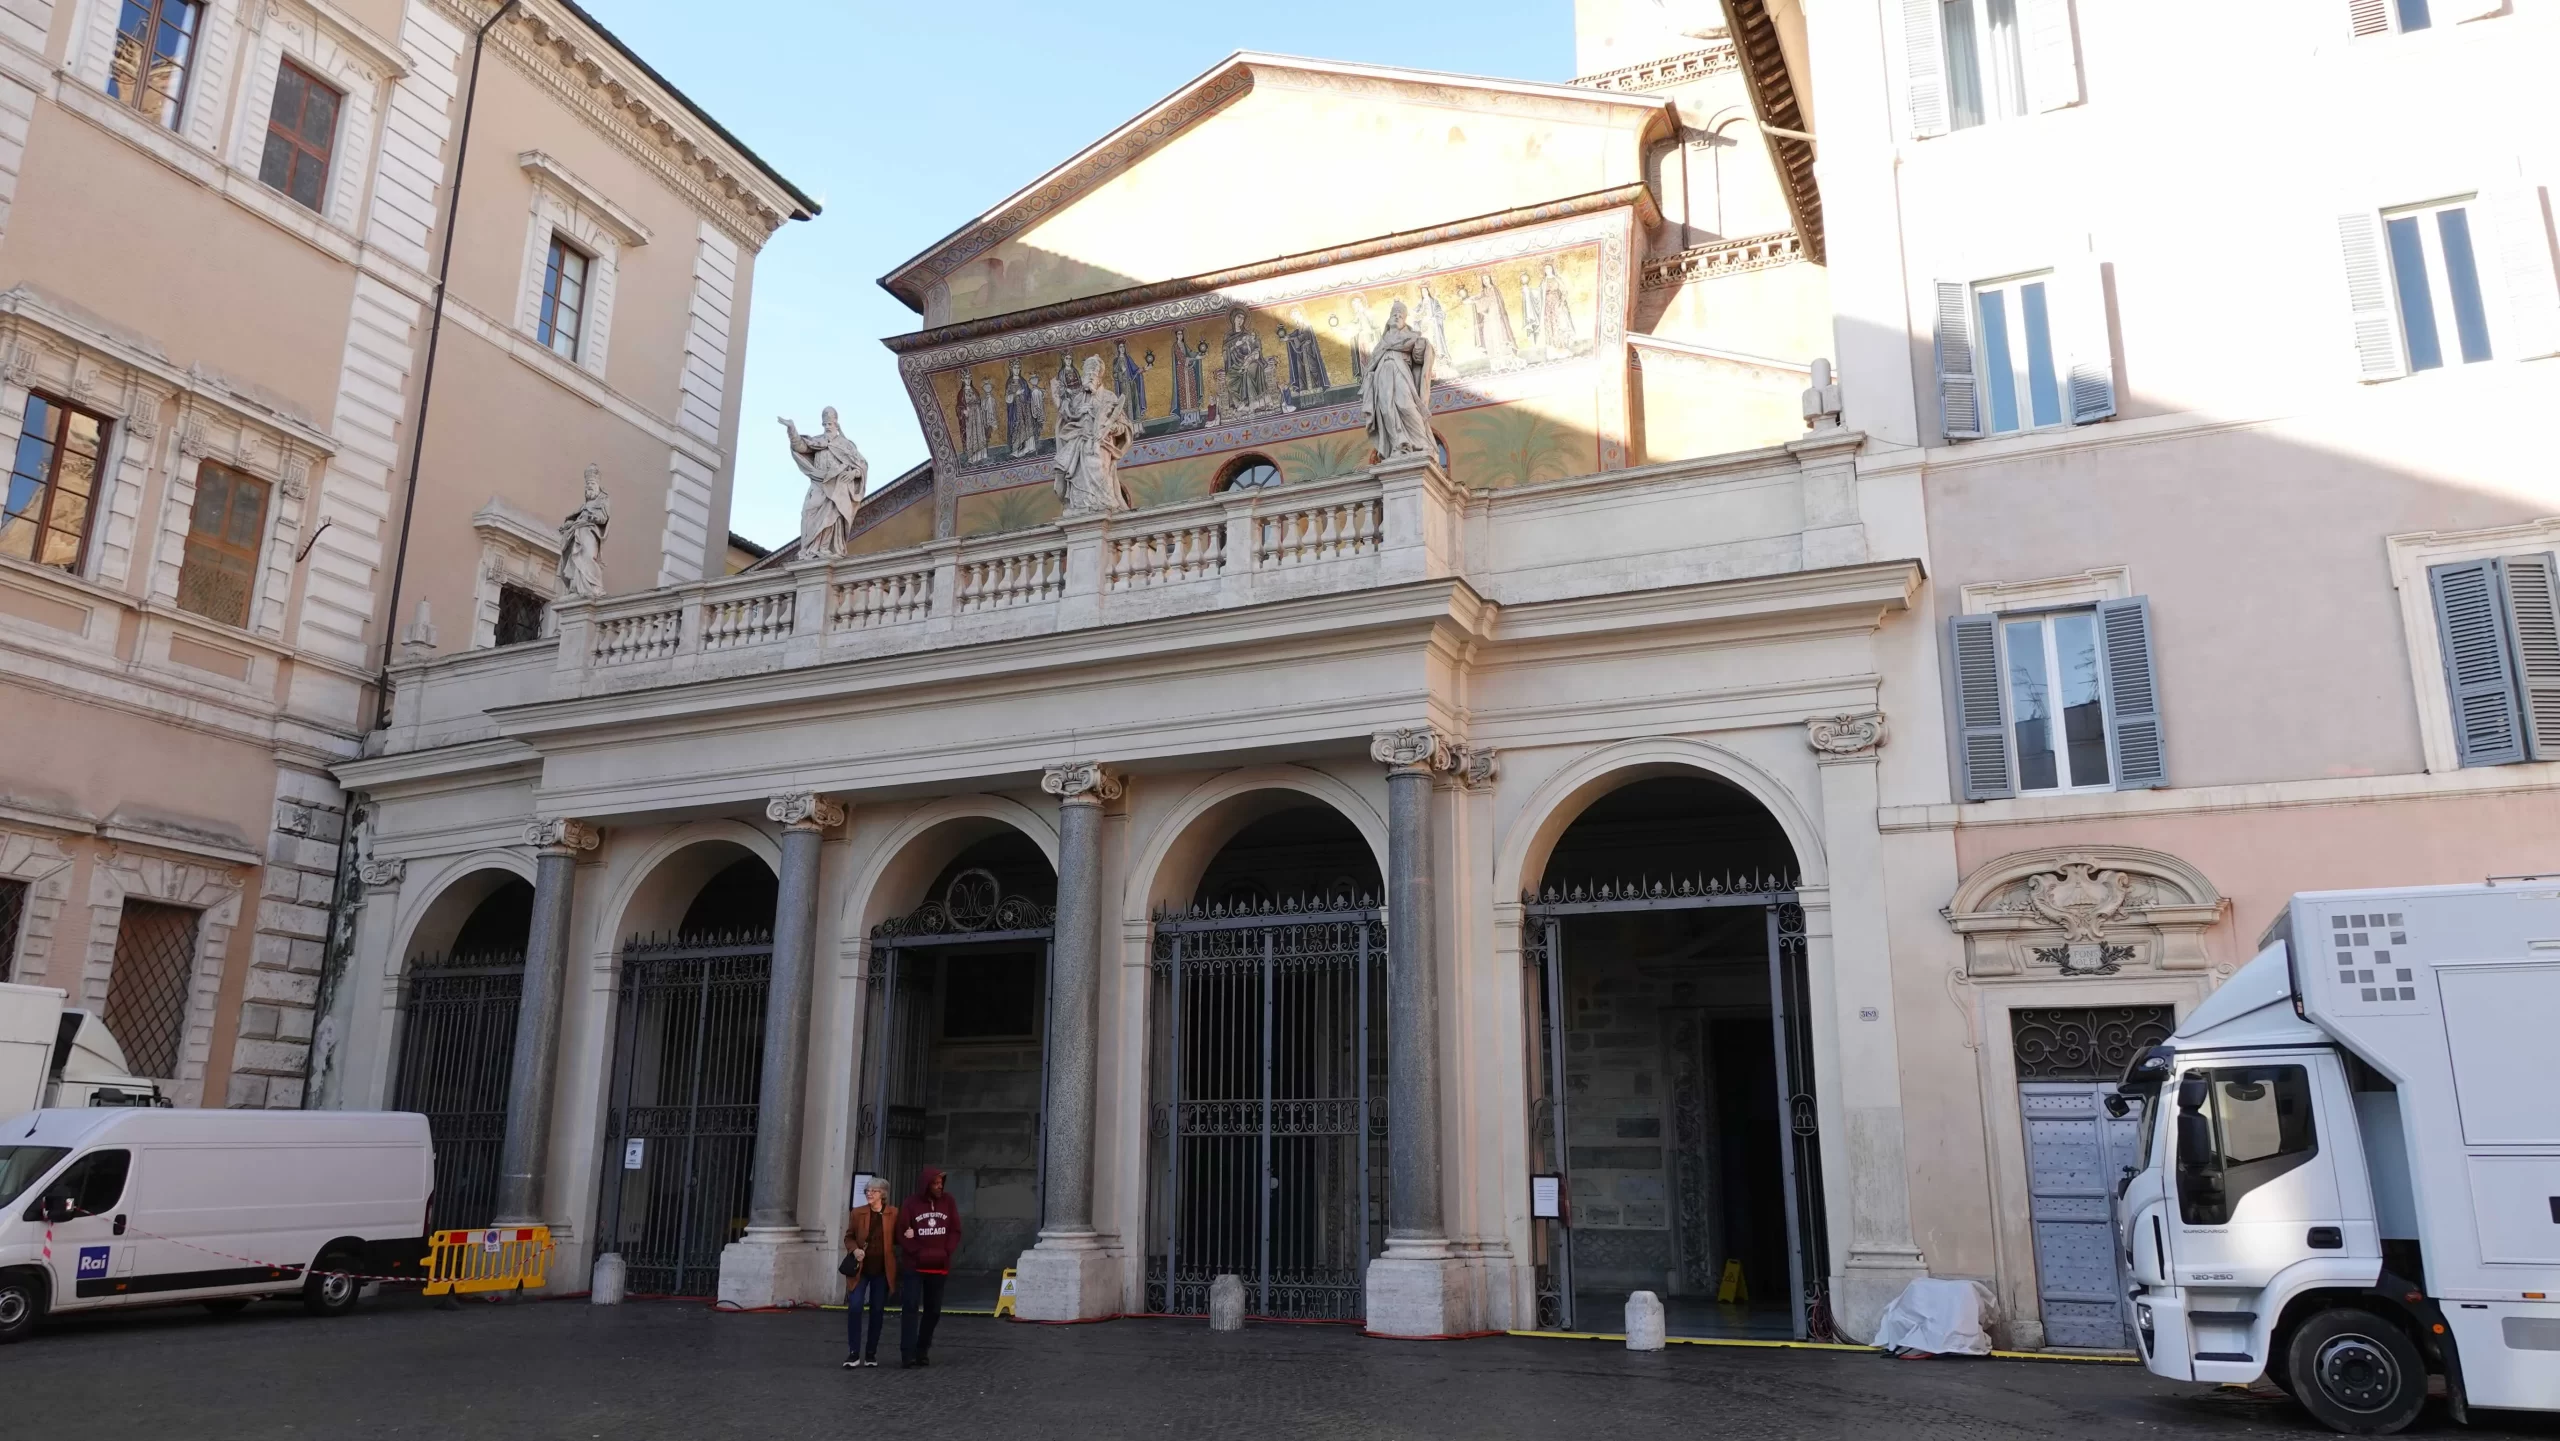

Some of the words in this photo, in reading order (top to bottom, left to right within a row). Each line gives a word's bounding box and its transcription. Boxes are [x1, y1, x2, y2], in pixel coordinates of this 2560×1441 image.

[2073, 950, 2099, 959] FONS
[918, 1227, 946, 1236] CHICAGO
[80, 1254, 107, 1271] Rai
